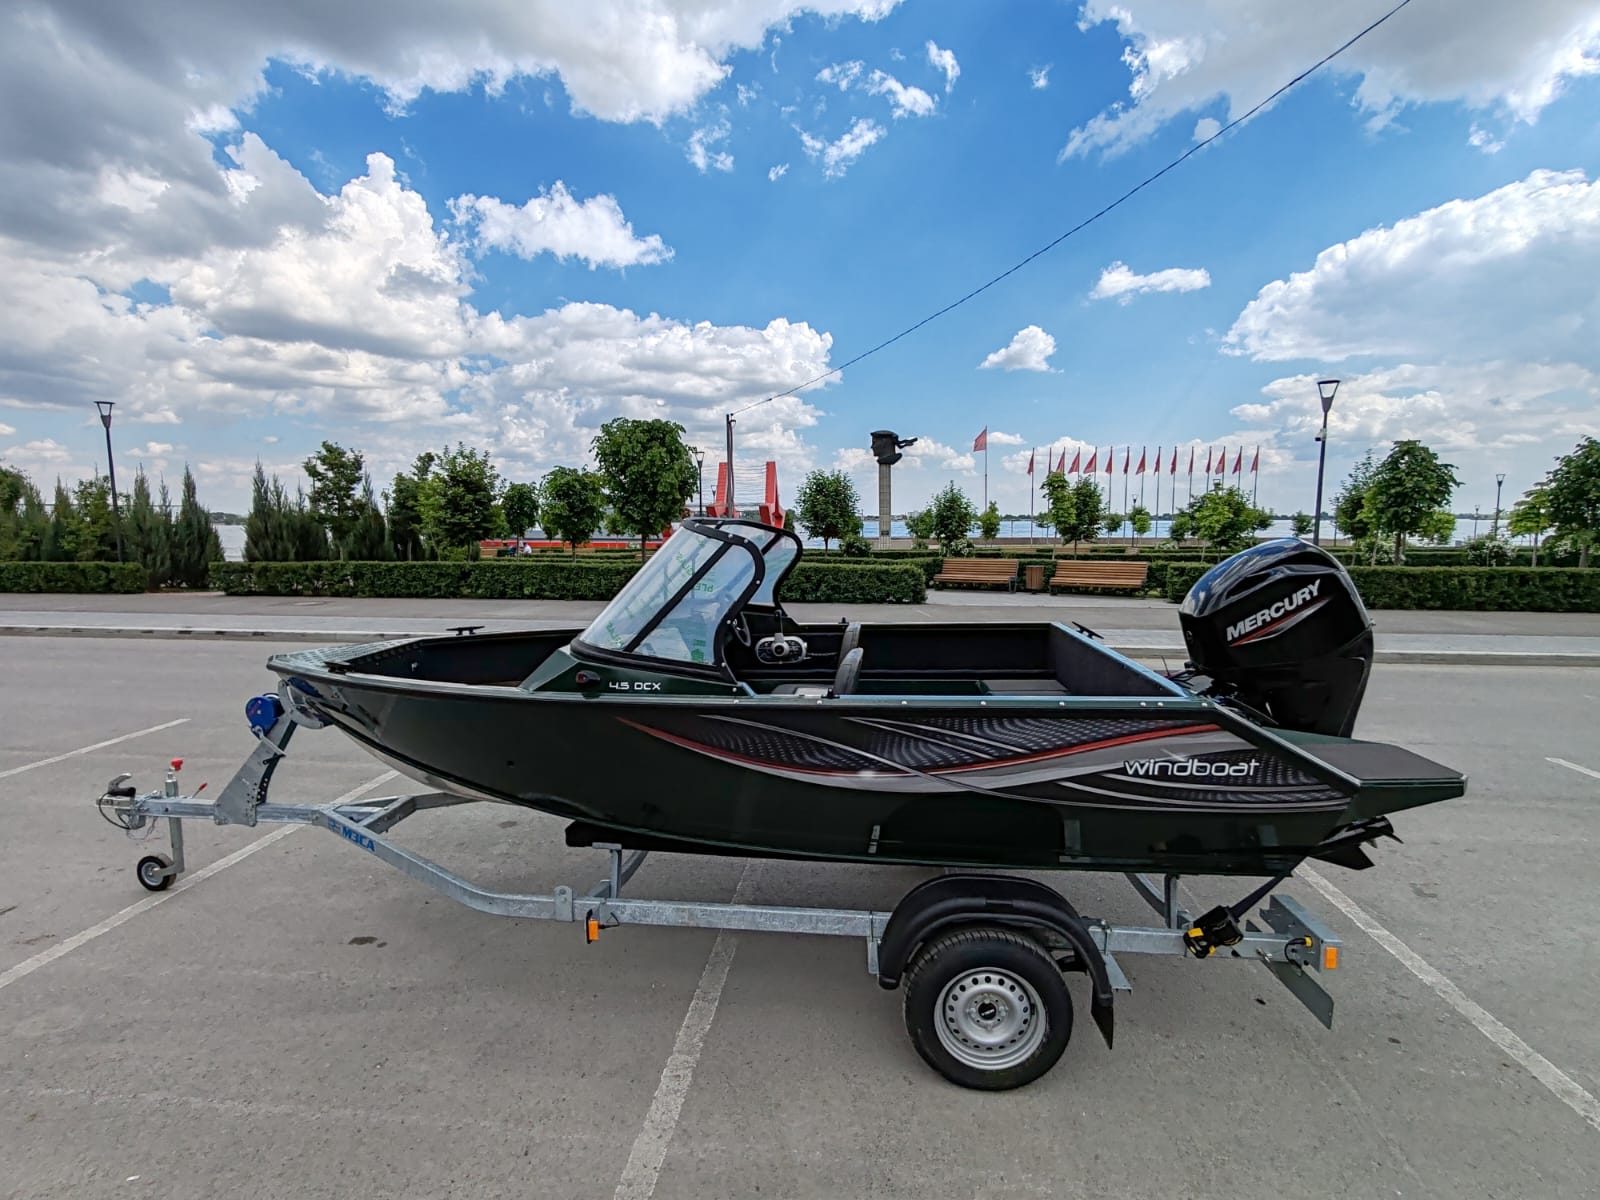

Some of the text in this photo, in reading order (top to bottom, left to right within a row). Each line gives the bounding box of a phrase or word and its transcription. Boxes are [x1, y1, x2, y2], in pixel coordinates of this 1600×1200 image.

[1226, 579, 1321, 641] MERCURY
[634, 681, 662, 690] DCX
[1124, 758, 1260, 776] windboat
